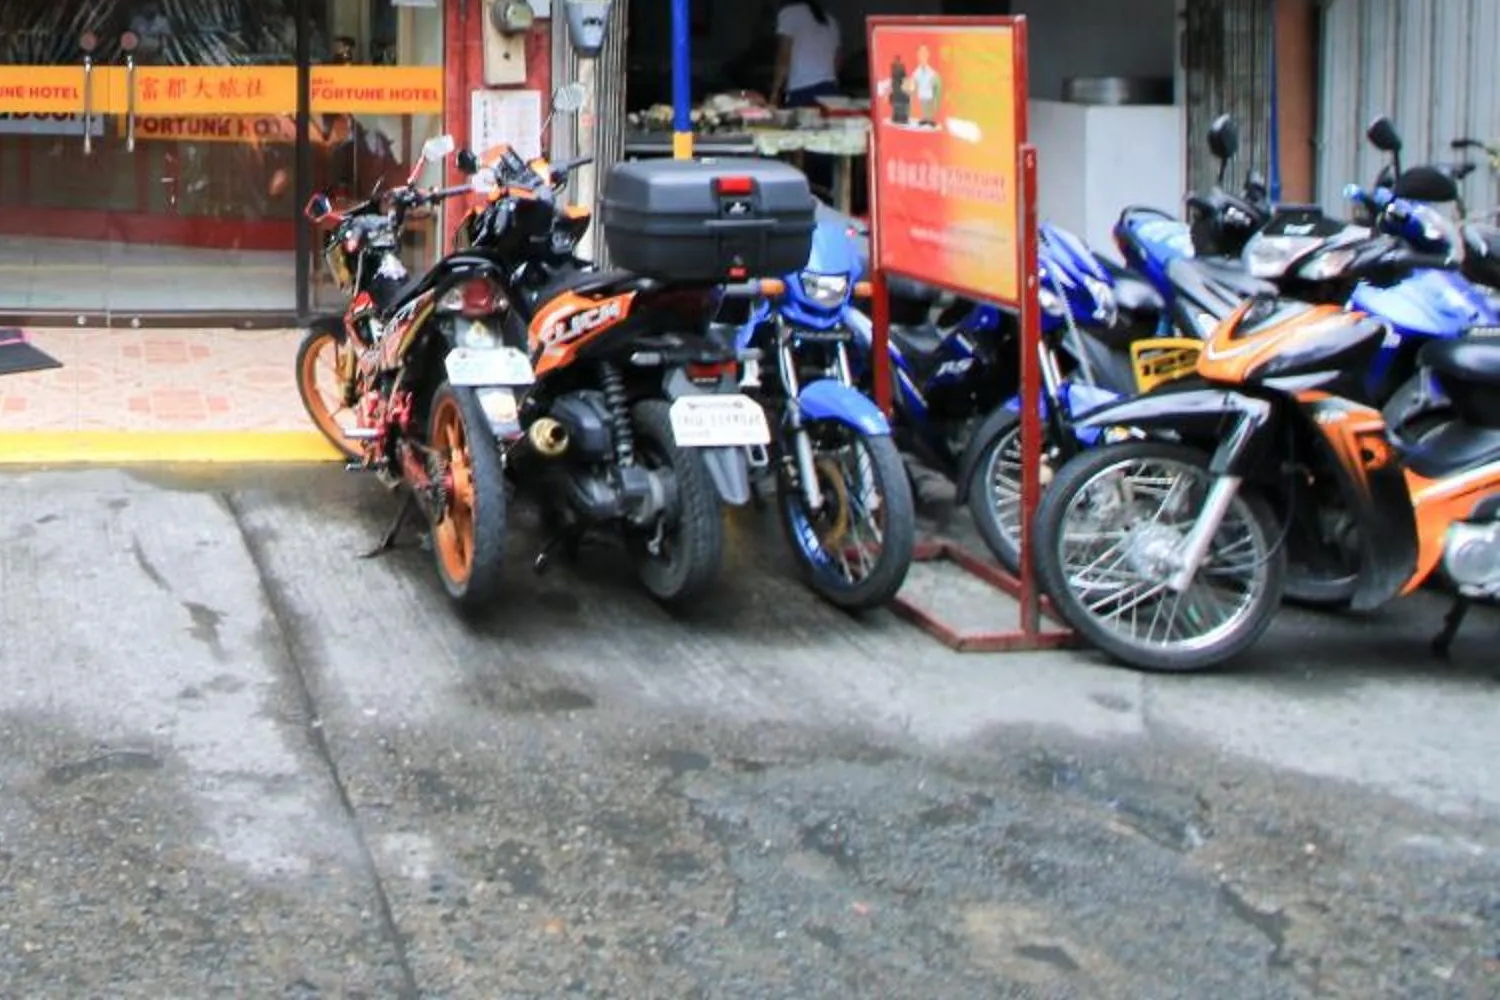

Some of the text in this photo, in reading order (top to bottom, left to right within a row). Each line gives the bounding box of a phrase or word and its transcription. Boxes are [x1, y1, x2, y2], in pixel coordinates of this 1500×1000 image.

[29, 86, 79, 100] HOTEL
[311, 87, 438, 101] FORTUNE HOTEL
